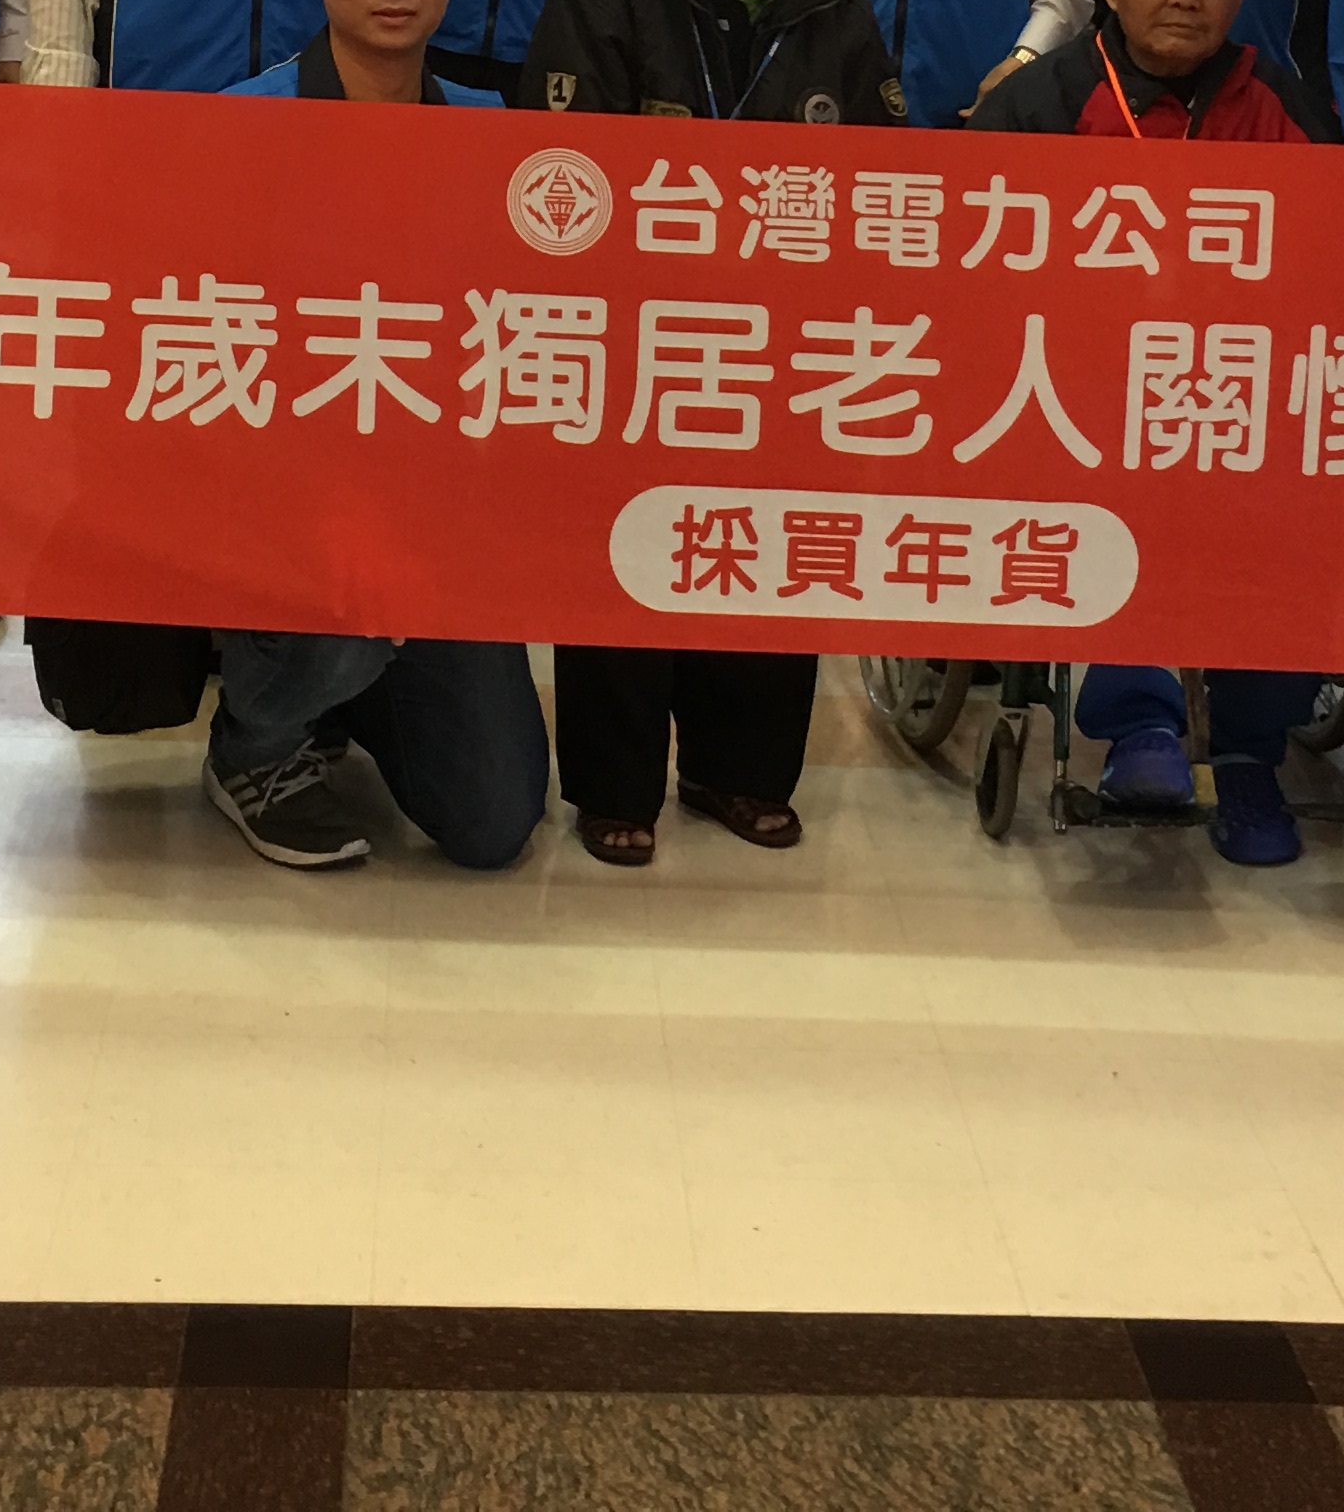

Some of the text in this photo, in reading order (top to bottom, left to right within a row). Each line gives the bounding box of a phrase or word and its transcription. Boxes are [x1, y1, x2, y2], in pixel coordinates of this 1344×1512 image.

[552, 75, 568, 103] 1
[629, 157, 1277, 281] 台灣電力公司
[670, 503, 1080, 612] 採買年貨
